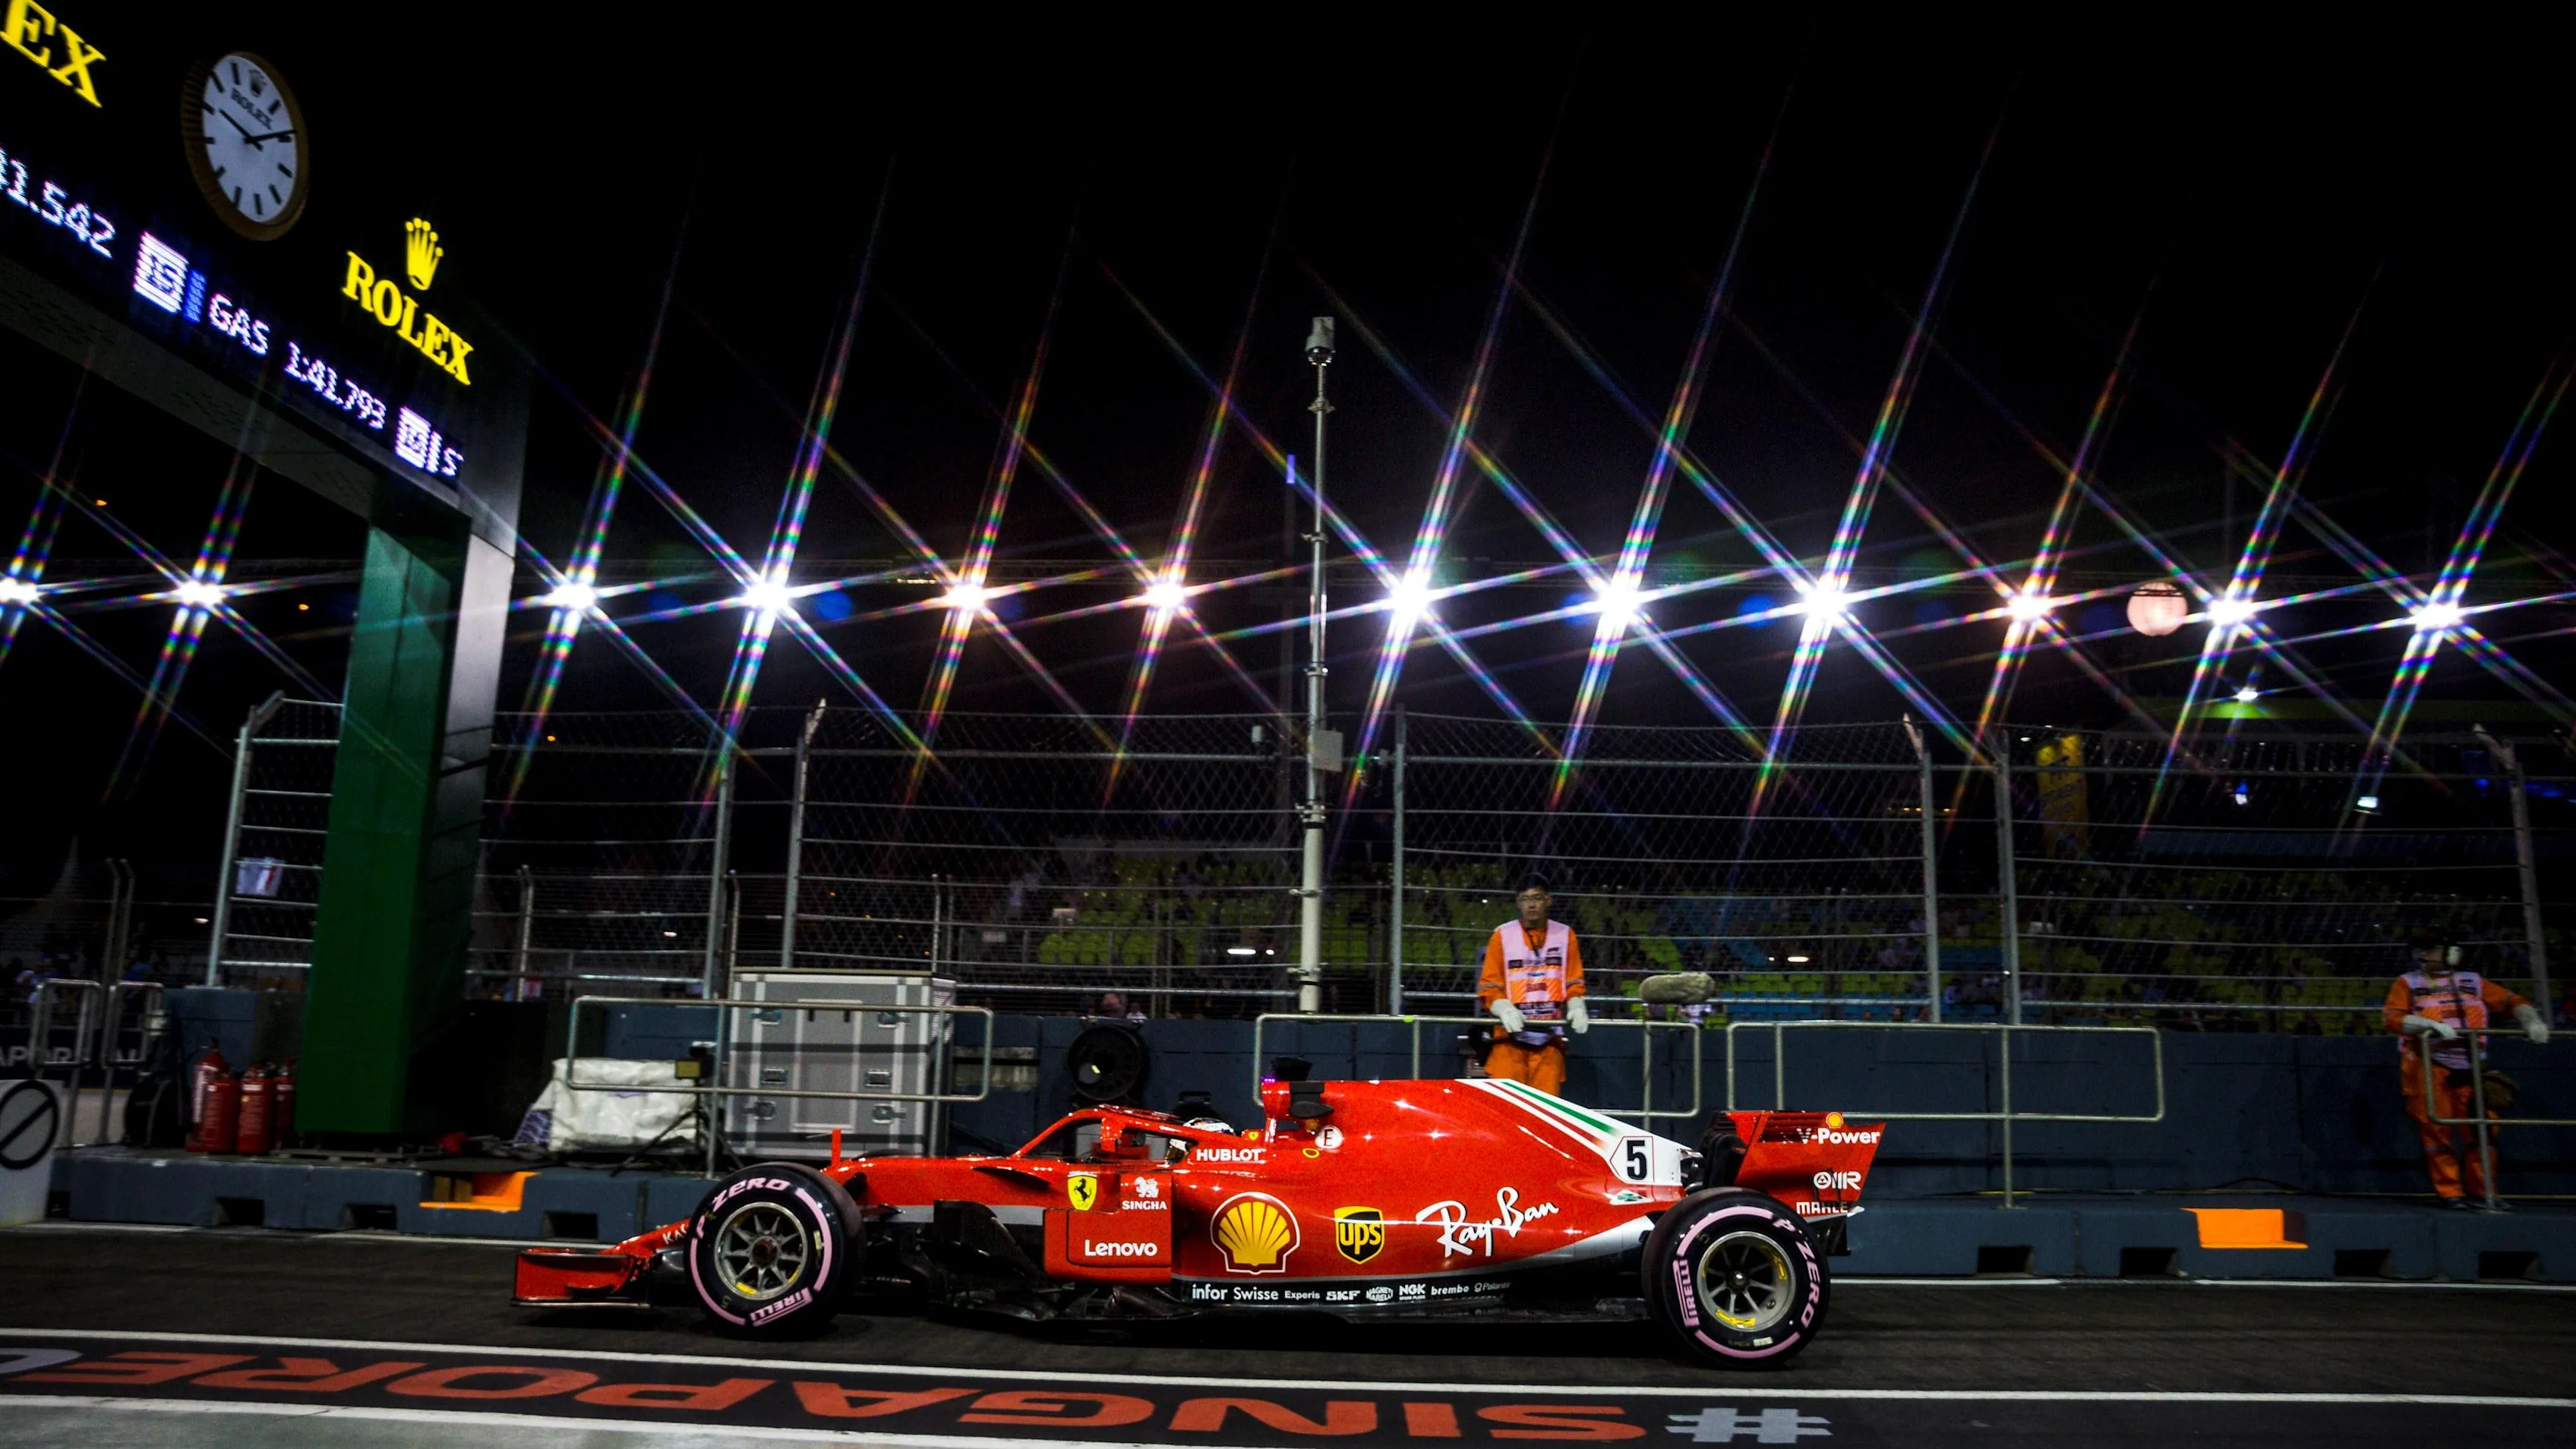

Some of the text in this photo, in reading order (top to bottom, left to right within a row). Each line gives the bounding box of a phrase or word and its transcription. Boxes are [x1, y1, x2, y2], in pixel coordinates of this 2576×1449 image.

[230, 87, 274, 131] ROLEX
[341, 250, 475, 386] ROLEX
[209, 292, 271, 357] GAS
[283, 340, 387, 431] 1:41.793
[1323, 1128, 1334, 1148] E
[1796, 1128, 1881, 1144] V-Power
[1196, 1148, 1261, 1162] HUBLOT
[1627, 1139, 1647, 1181] 5
[711, 1177, 791, 1213] ZERO
[1122, 1200, 1167, 1210] SINGHA
[1796, 1201, 1848, 1214] MAHLE
[1084, 1239, 1158, 1257] Lenovo
[1192, 1283, 1228, 1301] infor
[1399, 1283, 1426, 1296] NGK
[1431, 1285, 1470, 1296] brembo
[1672, 1258, 1700, 1327] PIRELLI
[1795, 1240, 1821, 1328] ZERO
[1233, 1286, 1279, 1301] Swisse
[1284, 1290, 1321, 1300] Experis
[1326, 1290, 1361, 1301] SKF
[750, 1287, 813, 1327] PIRELLI
